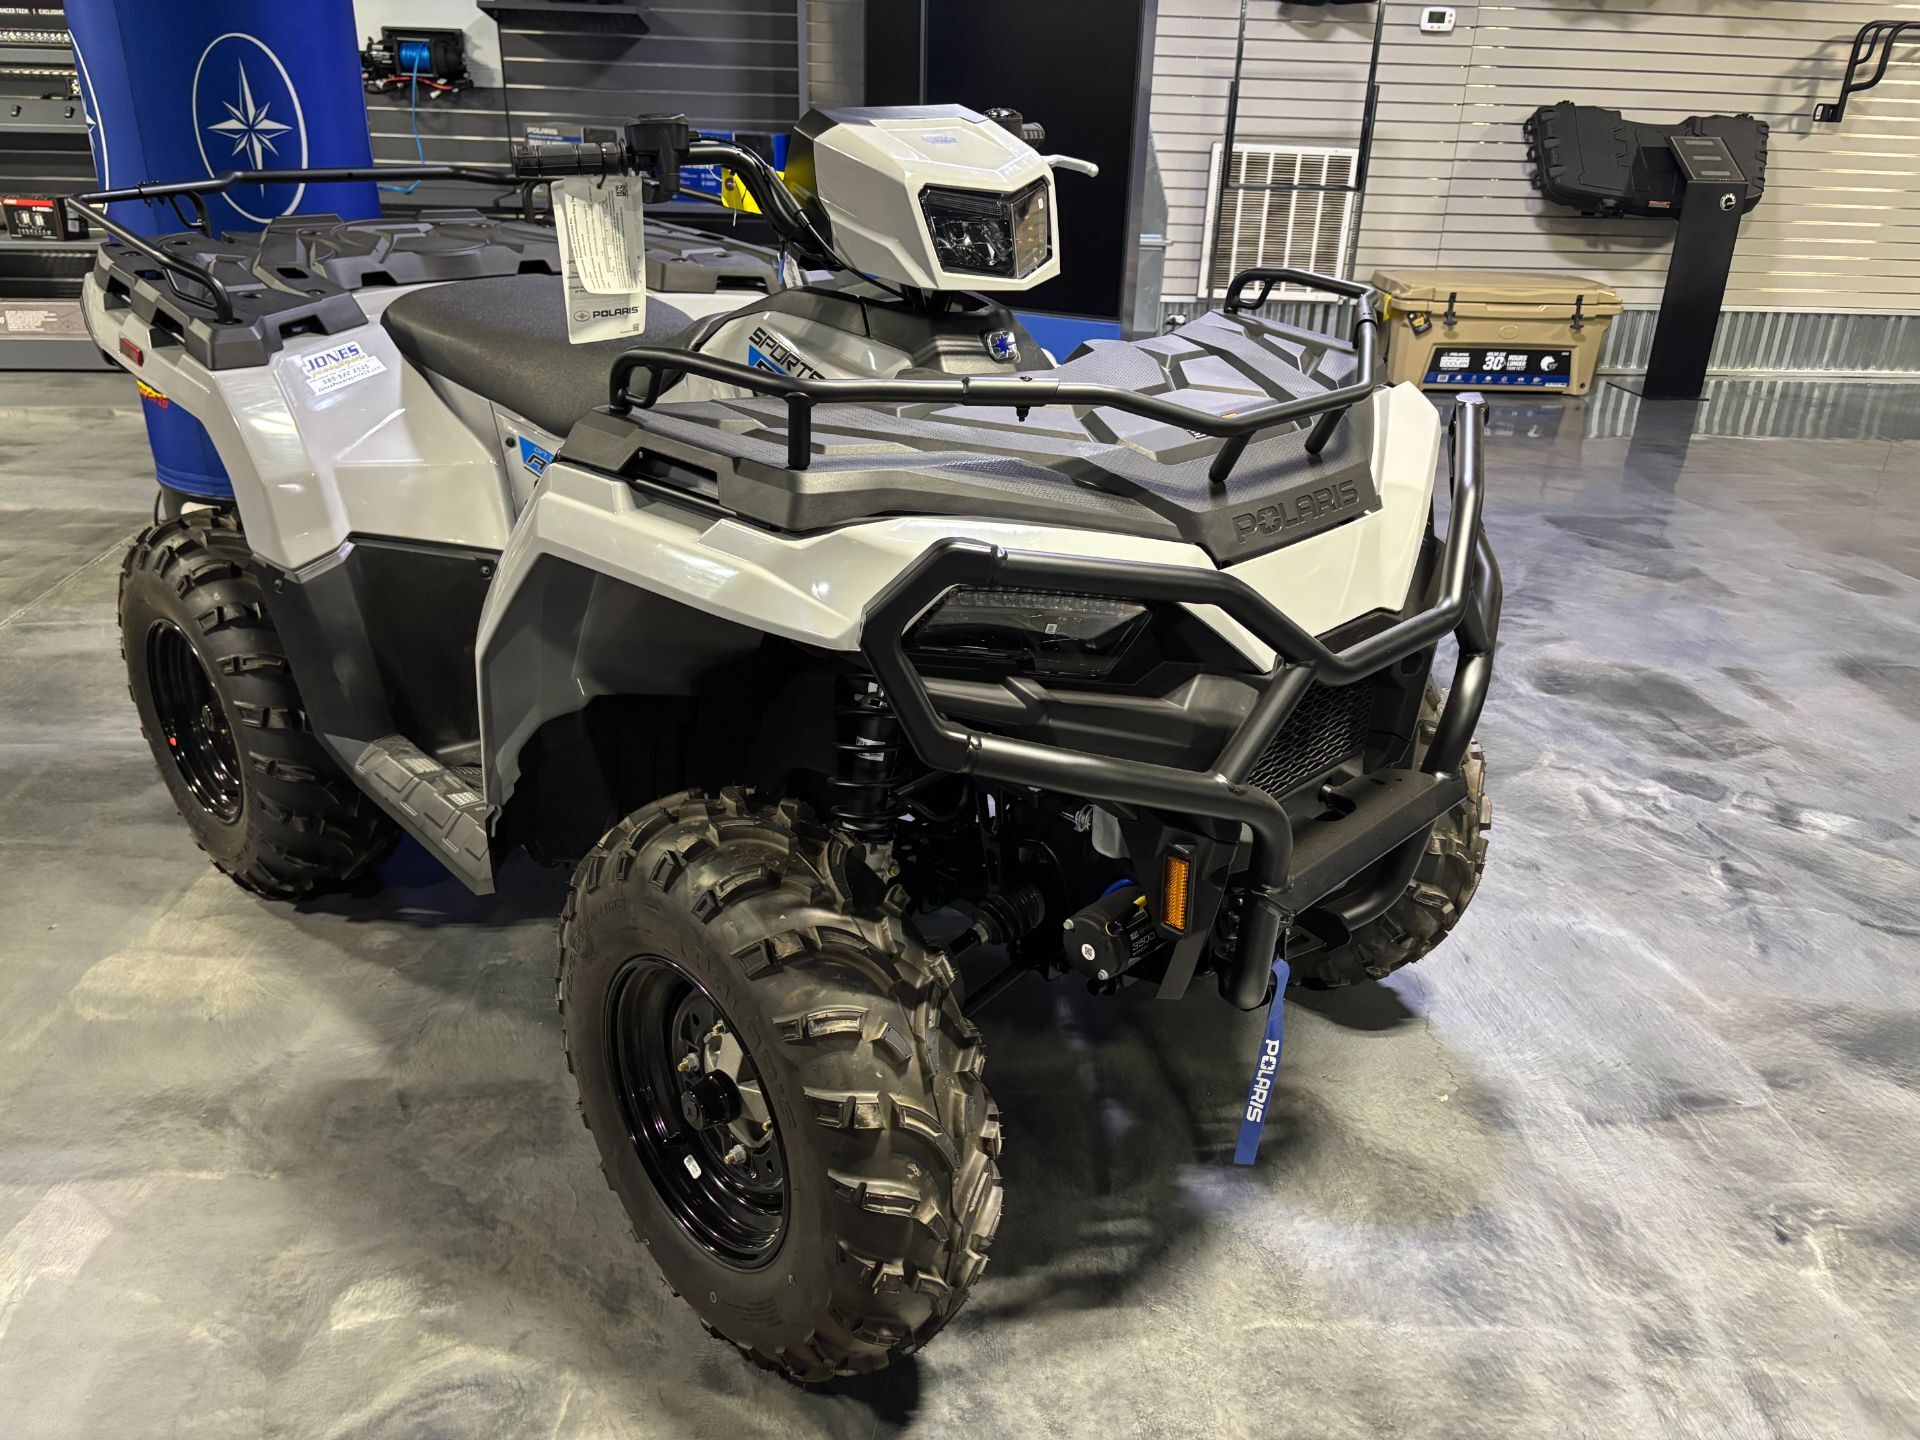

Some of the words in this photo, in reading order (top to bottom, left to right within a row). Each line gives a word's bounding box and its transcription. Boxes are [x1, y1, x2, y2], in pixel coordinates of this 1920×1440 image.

[592, 306, 639, 319] POLARIS
[307, 344, 360, 371] JONES
[1232, 479, 1360, 545] POLARIS
[1132, 931, 1156, 951] 3500
[1246, 1039, 1280, 1123] POLARIS
